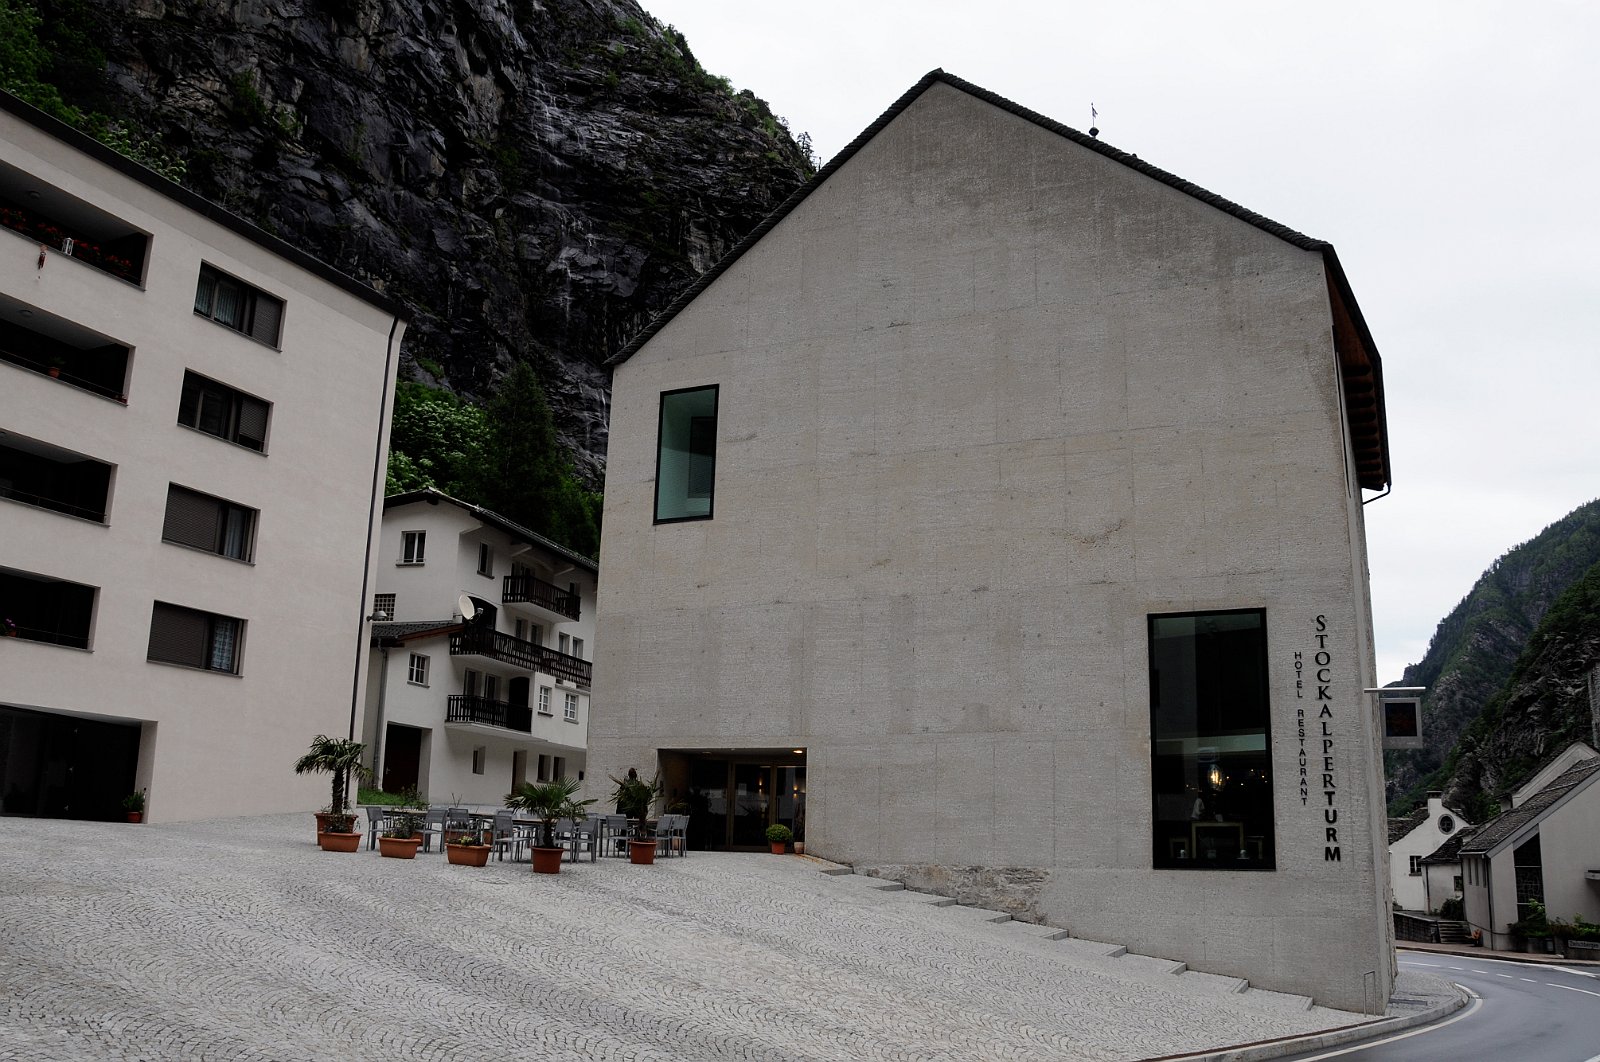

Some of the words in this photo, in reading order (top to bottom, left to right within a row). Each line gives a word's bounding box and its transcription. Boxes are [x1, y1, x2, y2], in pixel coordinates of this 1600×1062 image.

[1294, 651, 1303, 699] HOTEL
[1297, 709, 1308, 806] RESTAURANT
[1314, 614, 1341, 862] STOCKALPERTURM
